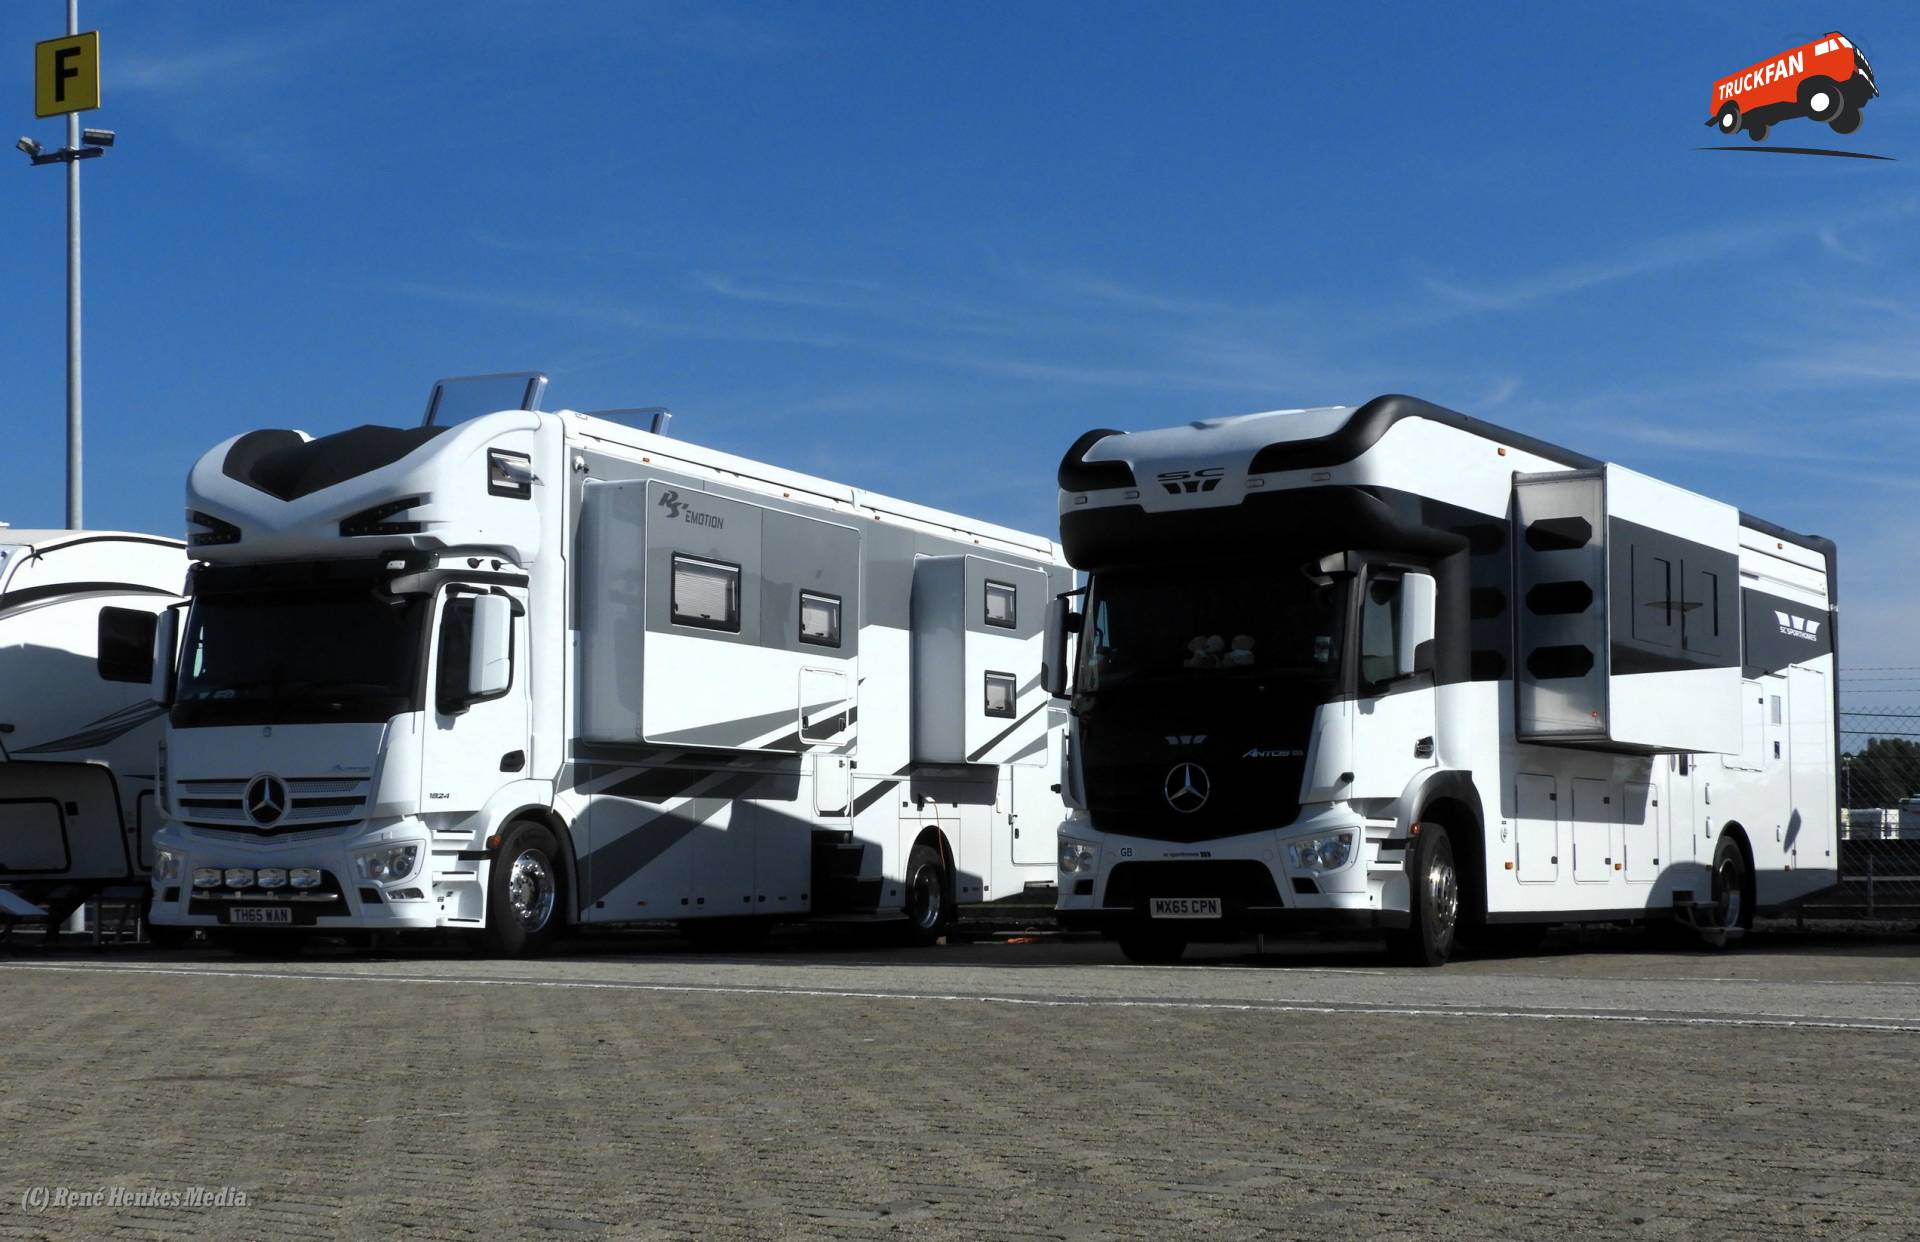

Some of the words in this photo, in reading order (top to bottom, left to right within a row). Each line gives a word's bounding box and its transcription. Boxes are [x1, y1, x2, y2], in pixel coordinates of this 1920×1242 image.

[55, 46, 81, 102] F
[1157, 467, 1224, 482] SC
[684, 510, 724, 530] EMOTION
[1120, 847, 1133, 857] GB
[1156, 900, 1188, 914] MX65
[1191, 900, 1216, 914] CPN
